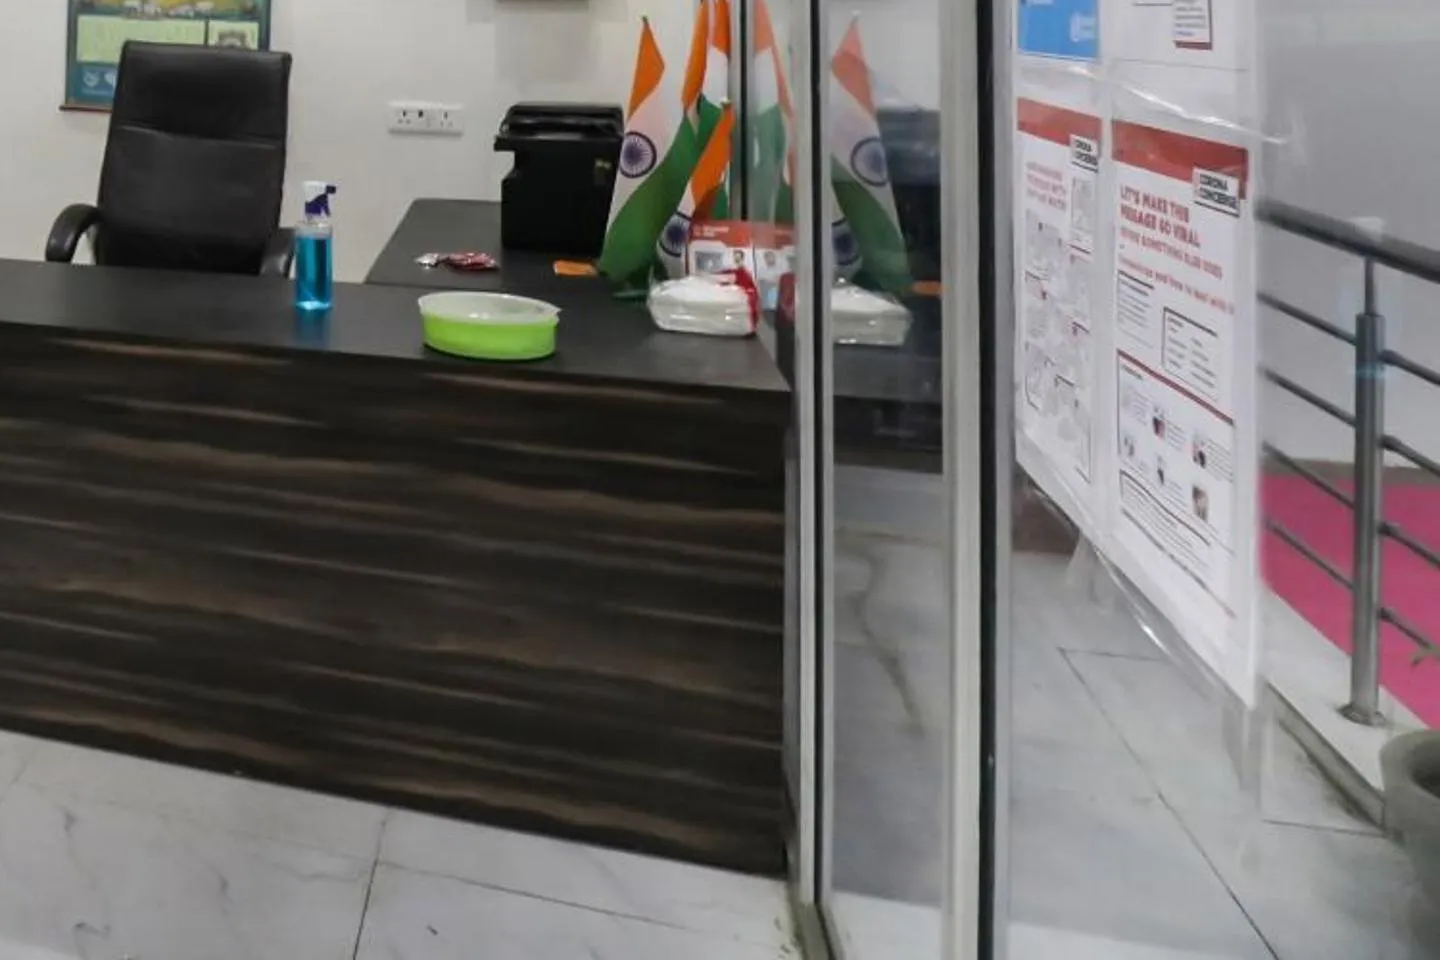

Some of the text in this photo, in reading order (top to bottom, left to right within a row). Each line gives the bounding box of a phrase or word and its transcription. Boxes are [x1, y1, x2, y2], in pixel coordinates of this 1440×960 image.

[1120, 184, 1190, 223] LET'S MAKE THIS
[1173, 224, 1201, 248] VIRAL
